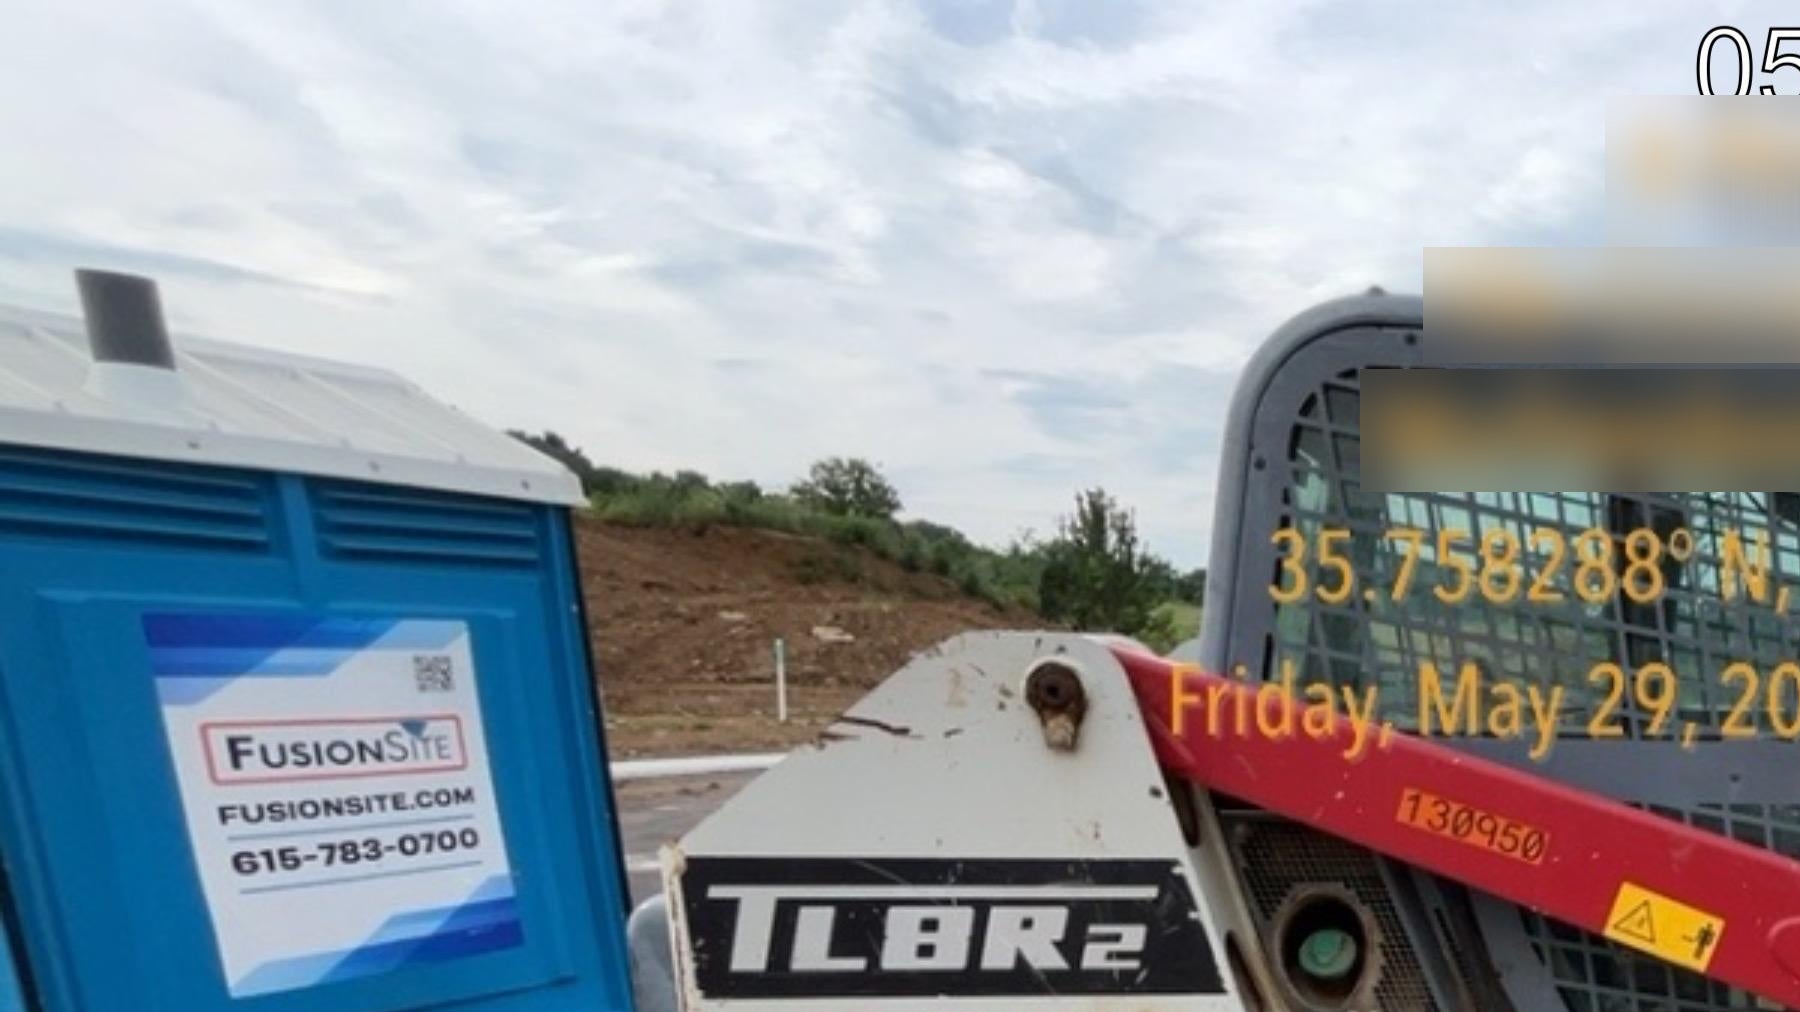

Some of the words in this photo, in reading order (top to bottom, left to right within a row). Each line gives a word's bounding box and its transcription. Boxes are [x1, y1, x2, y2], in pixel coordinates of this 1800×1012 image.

[219, 787, 475, 826] FUSIONSITE.COM
[1405, 793, 1545, 862] 130950
[231, 827, 480, 876] 615-783-0700
